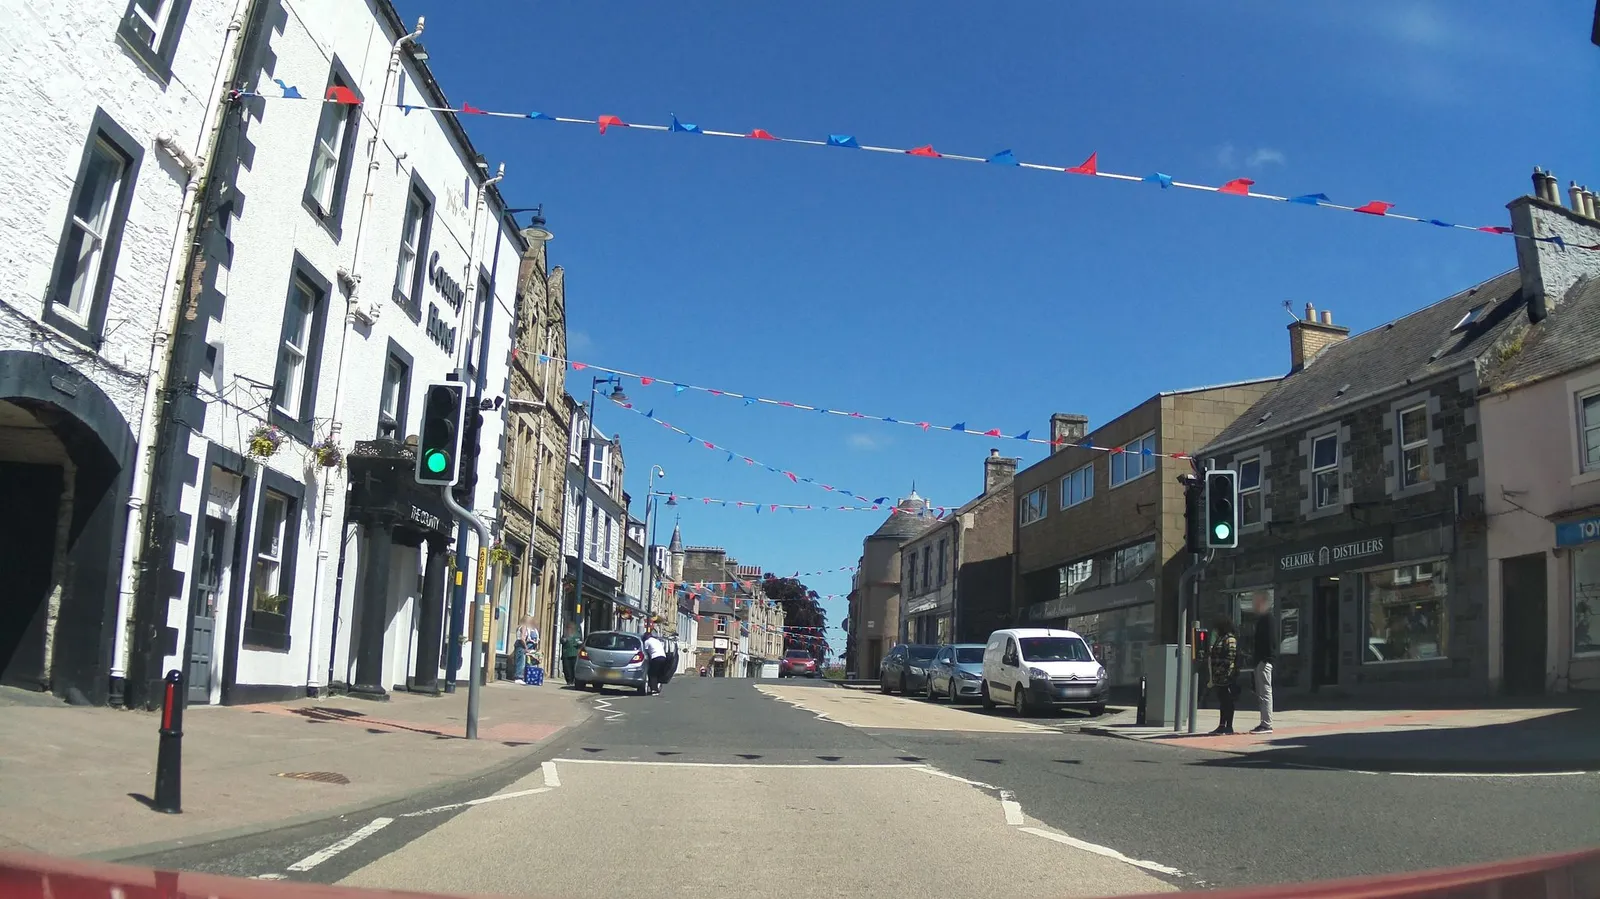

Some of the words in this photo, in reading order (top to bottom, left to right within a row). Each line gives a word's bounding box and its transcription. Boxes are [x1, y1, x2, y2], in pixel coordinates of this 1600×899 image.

[429, 250, 464, 318] County
[426, 301, 456, 358] Hotel
[411, 505, 421, 521] THE
[420, 511, 440, 530] COUNTY
[1280, 553, 1315, 570] SELKIRK
[1333, 539, 1384, 559] DISTILLERS
